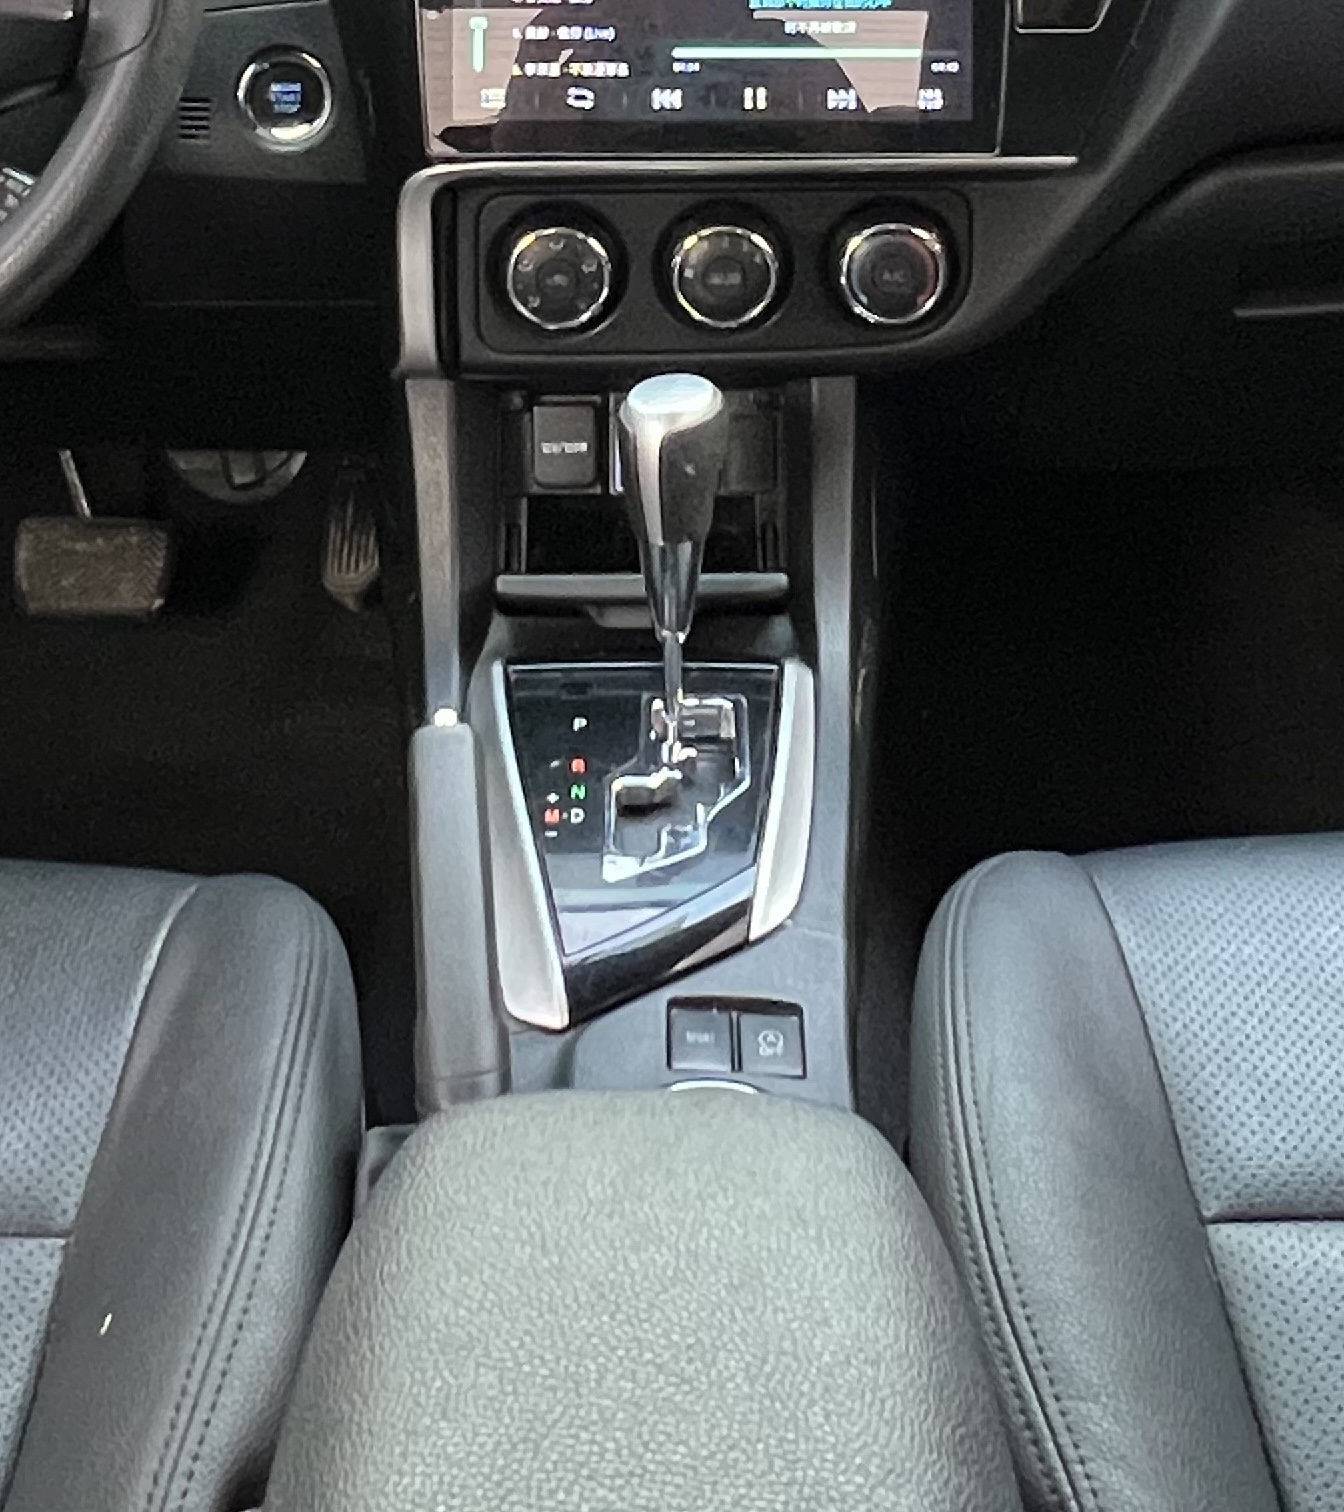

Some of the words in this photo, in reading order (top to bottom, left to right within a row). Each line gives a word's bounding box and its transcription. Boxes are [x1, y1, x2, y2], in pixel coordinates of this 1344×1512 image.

[572, 716, 588, 731] P
[570, 784, 586, 800] N
[570, 807, 586, 824] D
